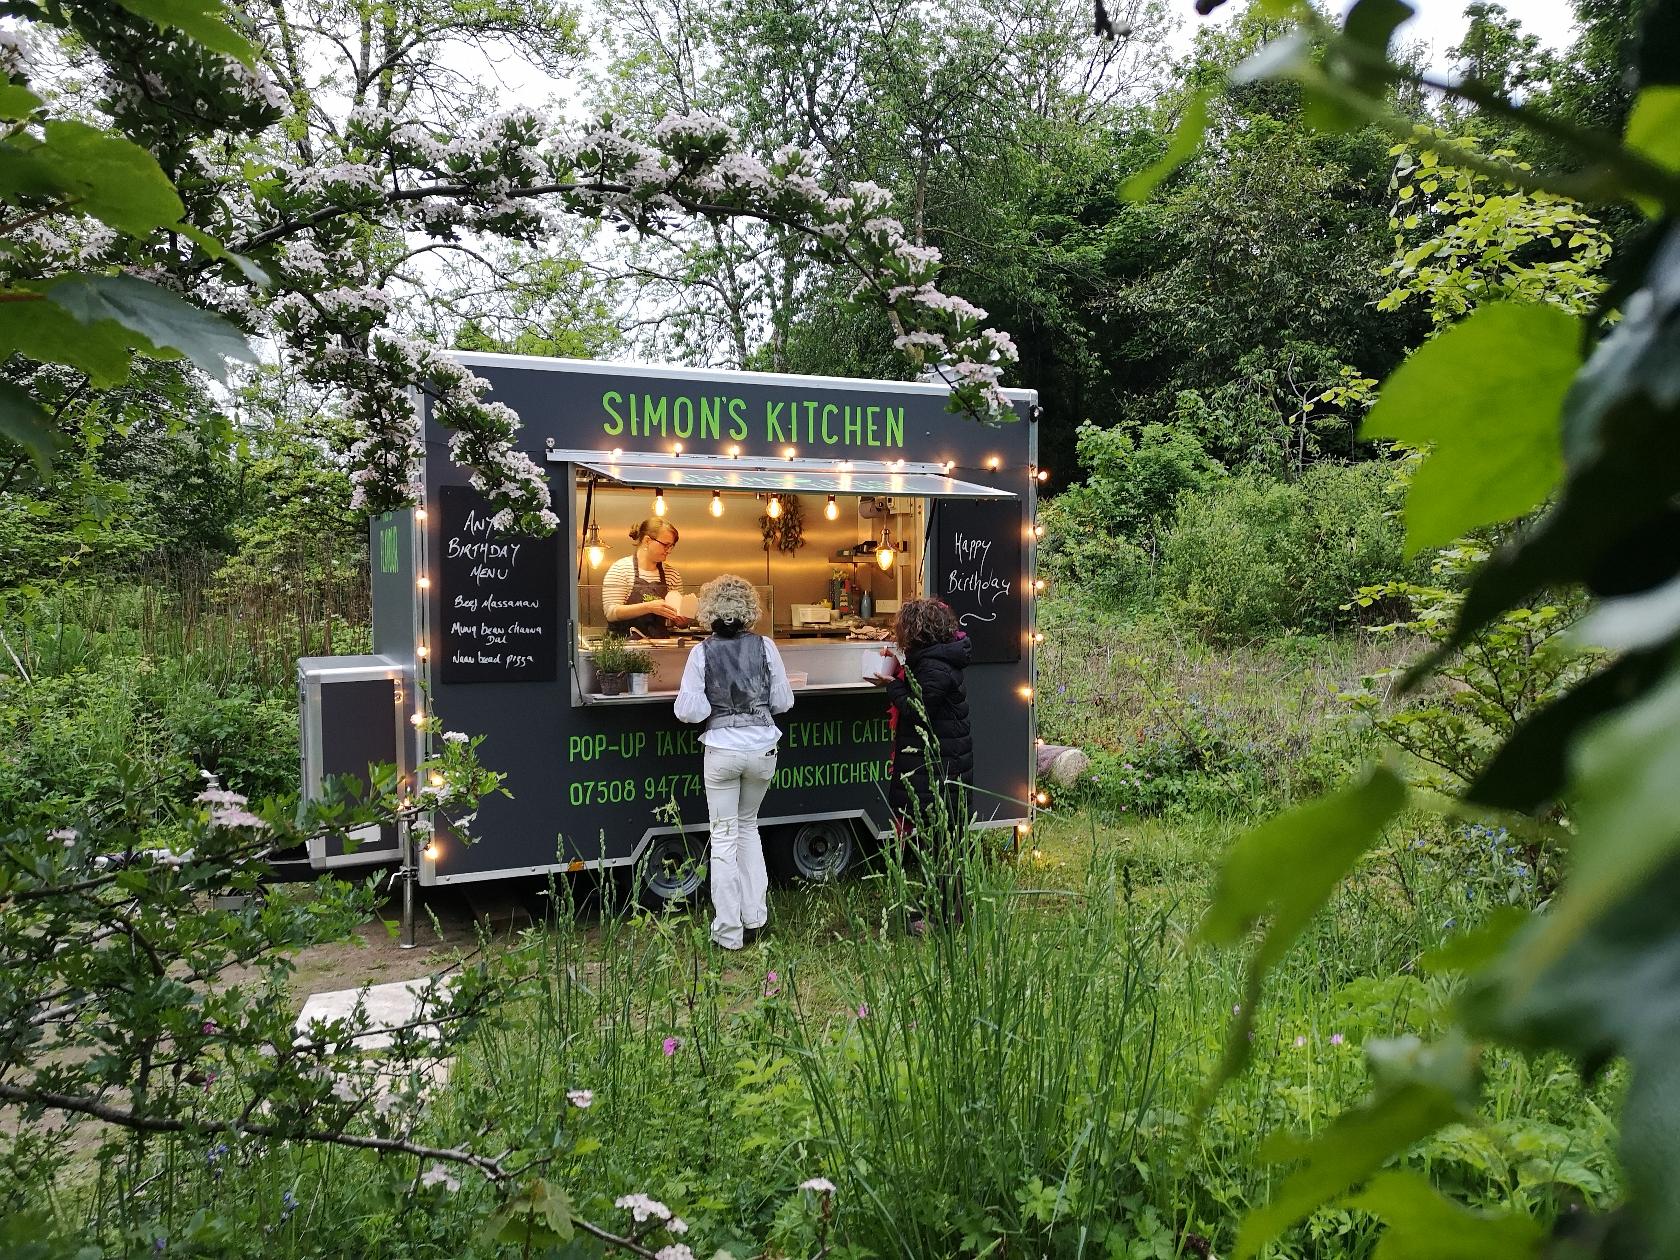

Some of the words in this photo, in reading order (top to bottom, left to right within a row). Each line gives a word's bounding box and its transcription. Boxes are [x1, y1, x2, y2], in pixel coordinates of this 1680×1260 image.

[602, 390, 749, 442] SIMON'S
[766, 400, 905, 448] KITCHEN
[954, 531, 992, 577] Happy
[453, 594, 478, 612] Beef
[946, 568, 1011, 608] Birthday
[505, 654, 535, 669] pizza
[569, 731, 646, 763] POP-UP
[788, 719, 844, 748] EVENT
[569, 778, 637, 806] 07508
[644, 773, 706, 800] 94774
